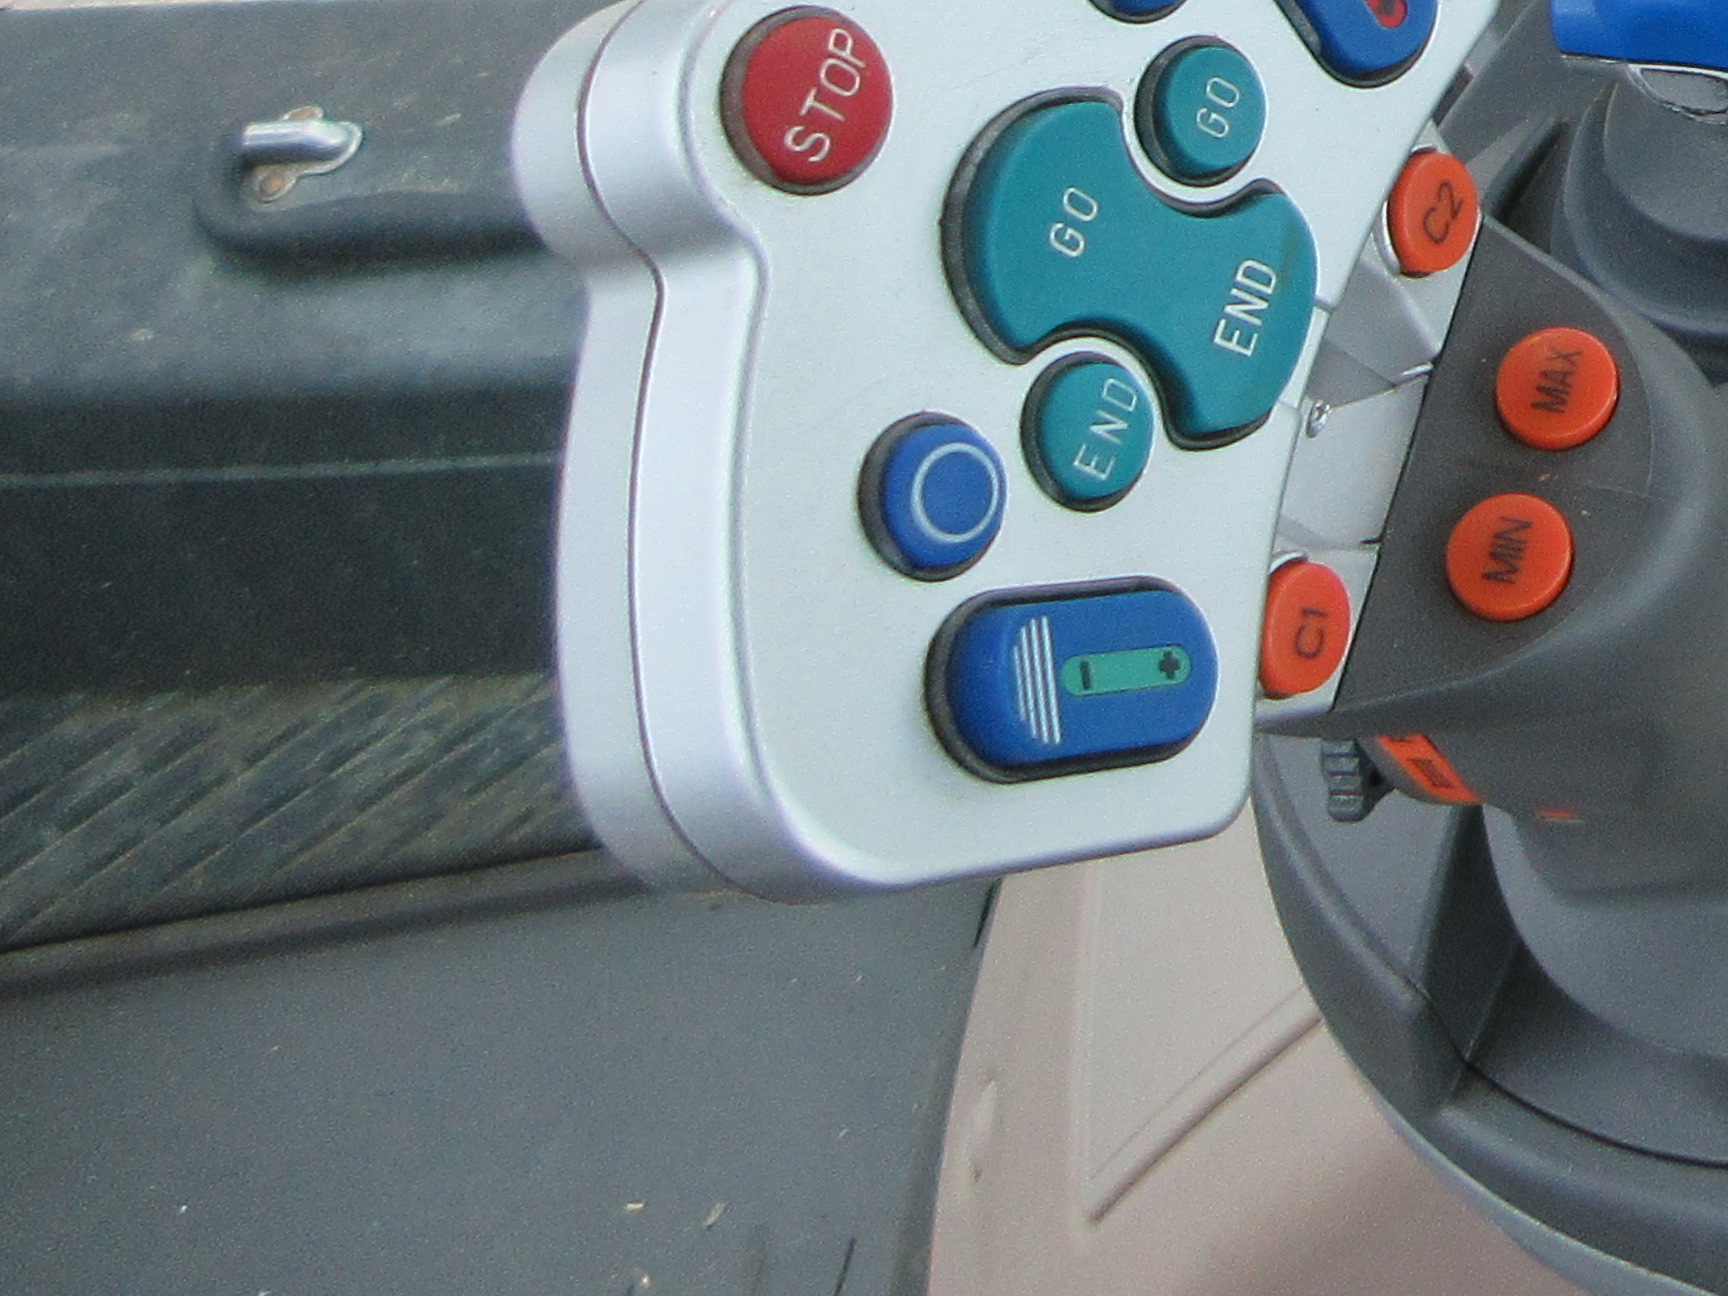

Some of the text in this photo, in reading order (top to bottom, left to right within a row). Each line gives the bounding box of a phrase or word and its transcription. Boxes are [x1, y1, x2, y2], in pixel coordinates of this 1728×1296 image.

[783, 27, 870, 165] STOP
[1195, 75, 1242, 142] GO
[1048, 185, 1100, 260] GO
[1424, 180, 1465, 246] C2
[1212, 255, 1280, 360] END
[1530, 344, 1585, 415] MAX
[1073, 375, 1140, 483] END
[1480, 515, 1533, 586] MIN
[1296, 605, 1326, 661] C1
